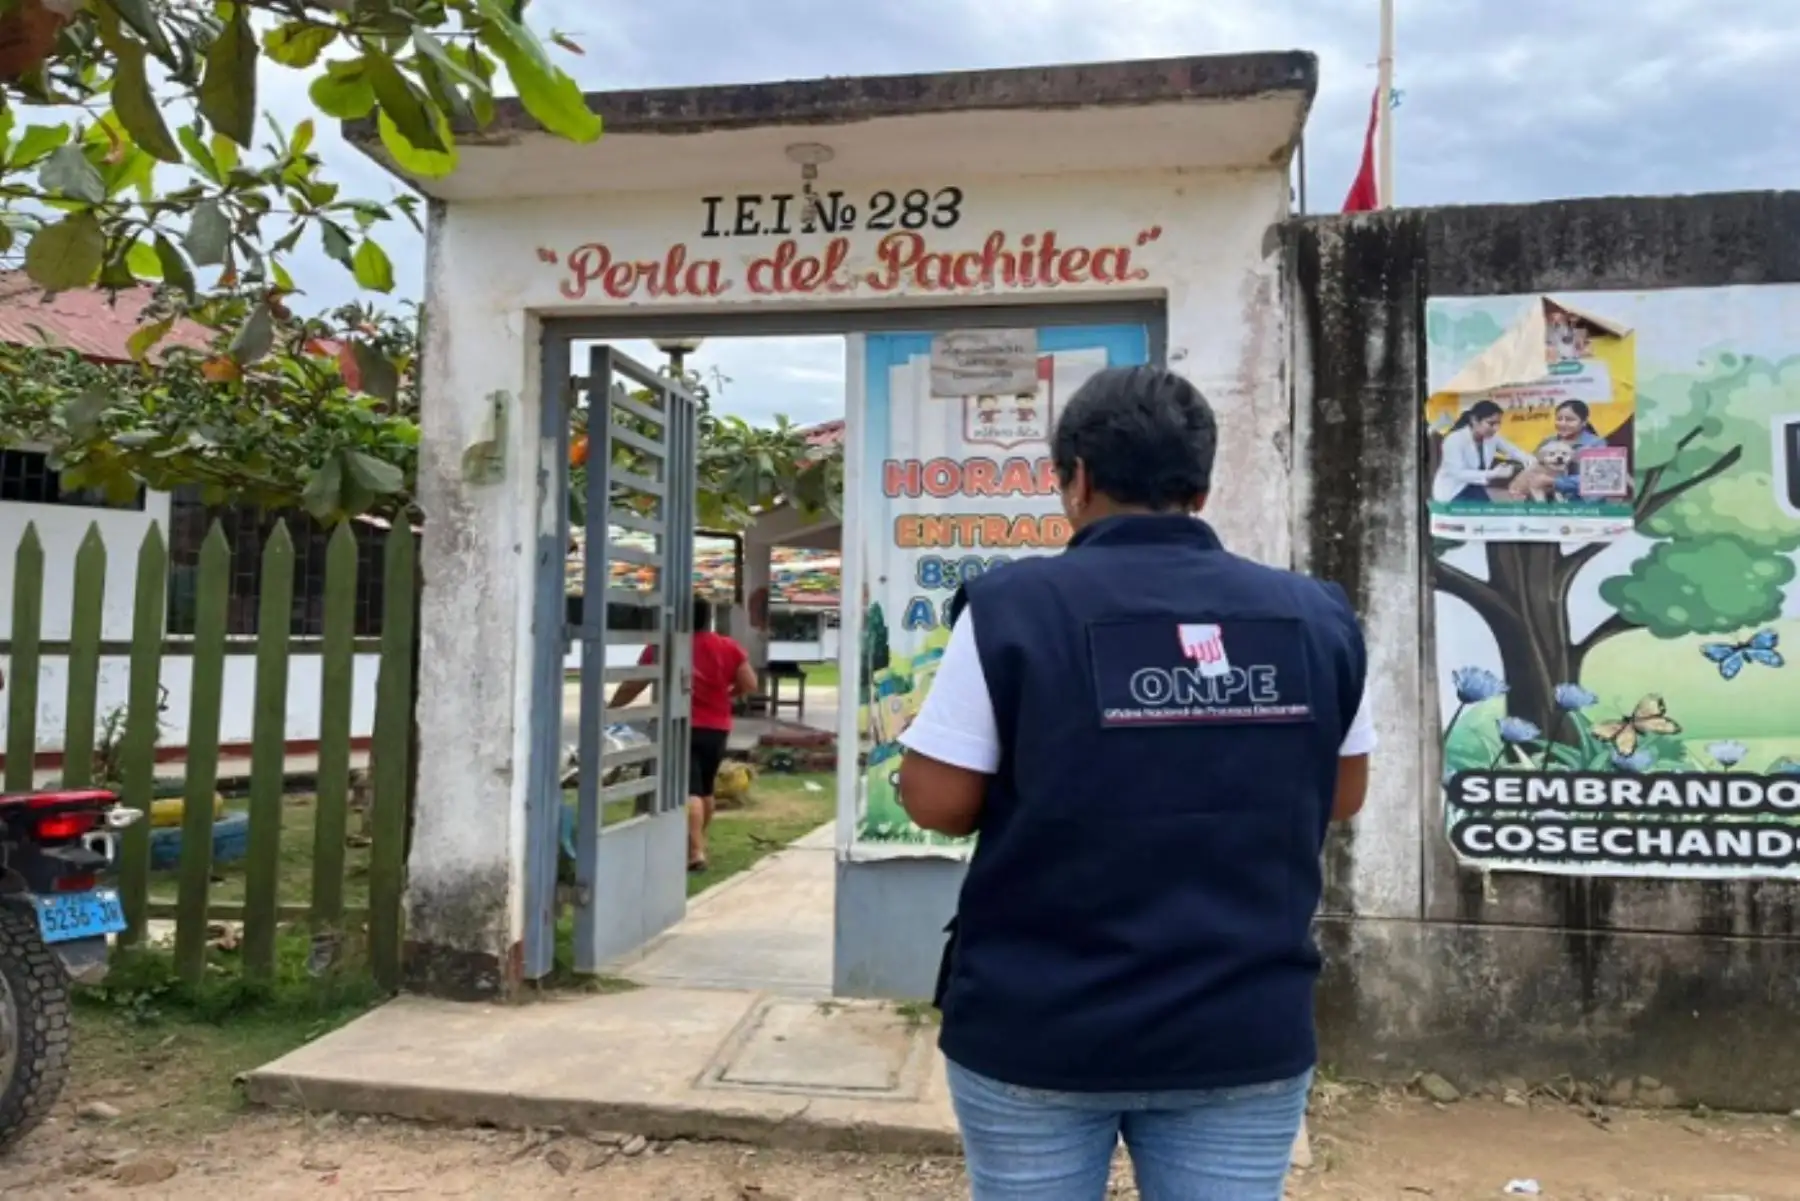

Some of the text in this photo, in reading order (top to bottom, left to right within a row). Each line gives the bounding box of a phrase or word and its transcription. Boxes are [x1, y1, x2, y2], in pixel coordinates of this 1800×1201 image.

[700, 194, 795, 237] I.E.I
[866, 186, 964, 231] 283
[746, 236, 851, 294] del
[883, 456, 1062, 498] HORAR
[895, 512, 1075, 548] ENTRAD
[916, 554, 1014, 590] 8:0
[1130, 664, 1279, 705] ONPE
[1461, 776, 1800, 808] SEMBRANDO
[1461, 823, 1800, 857] COSECHAND
